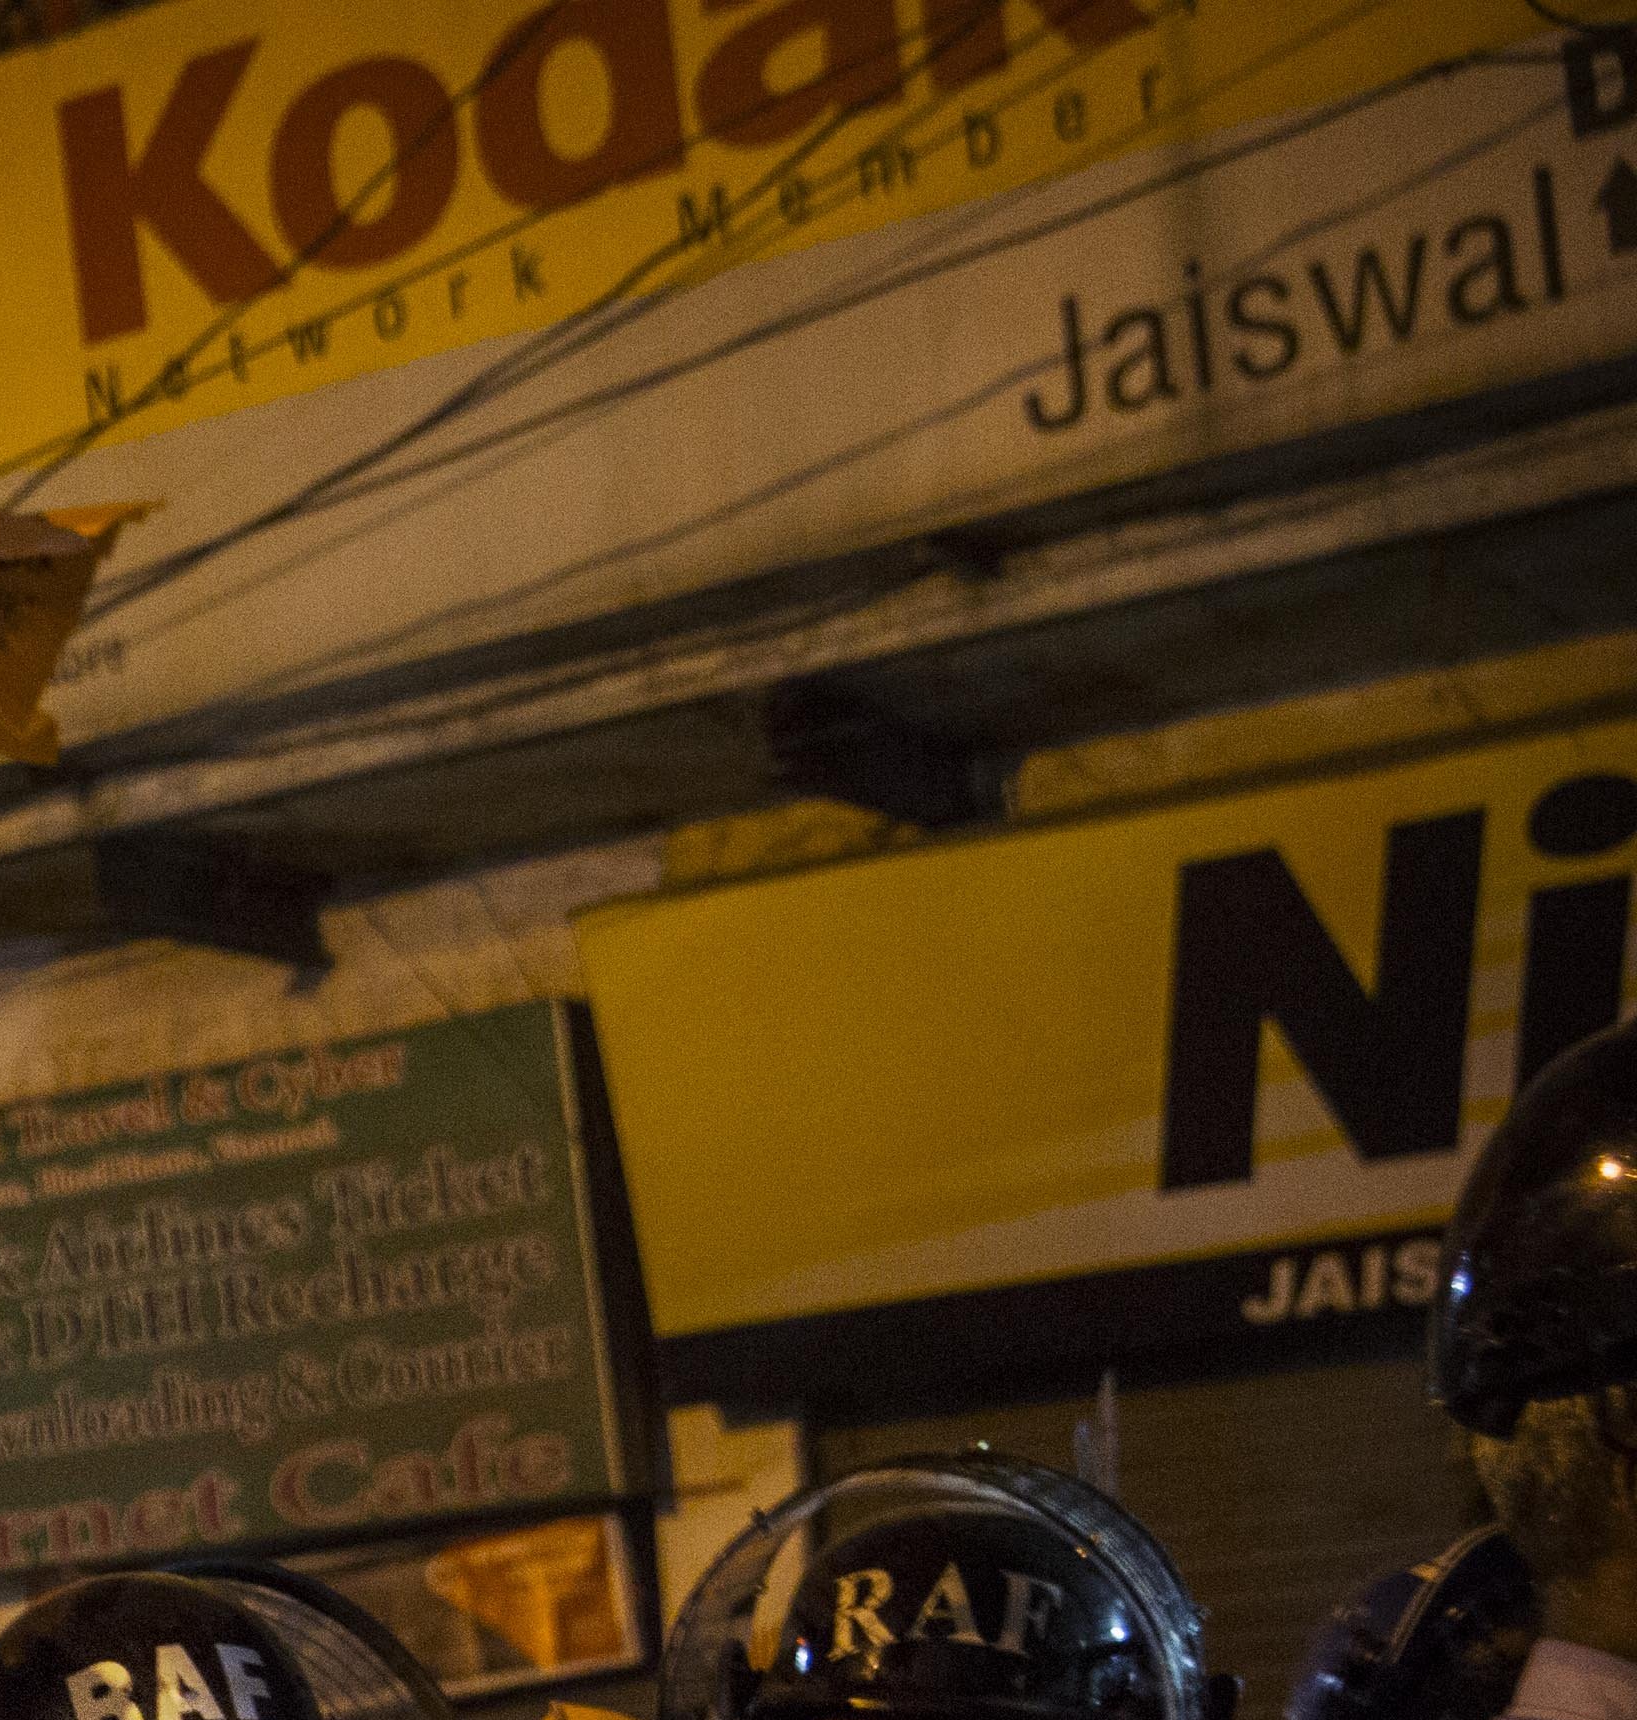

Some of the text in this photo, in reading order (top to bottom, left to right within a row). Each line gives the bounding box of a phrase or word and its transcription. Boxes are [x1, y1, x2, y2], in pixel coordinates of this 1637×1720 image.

[85, 66, 1159, 425] Network Member
[1021, 163, 1565, 432] Jaiswal
[9, 1070, 174, 1159] Travel
[180, 1068, 231, 1126] &
[236, 1043, 408, 1119] Cyber
[37, 1197, 308, 1296] Airlines
[313, 1142, 548, 1240] Ticket
[24, 1277, 208, 1370] DTH
[217, 1232, 558, 1343] Recharge
[1239, 1236, 1444, 1328] JAIS
[276, 1350, 333, 1419] &
[336, 1326, 575, 1412] Courier
[269, 1410, 573, 1528] Cafe
[825, 1559, 1065, 1663] RAF
